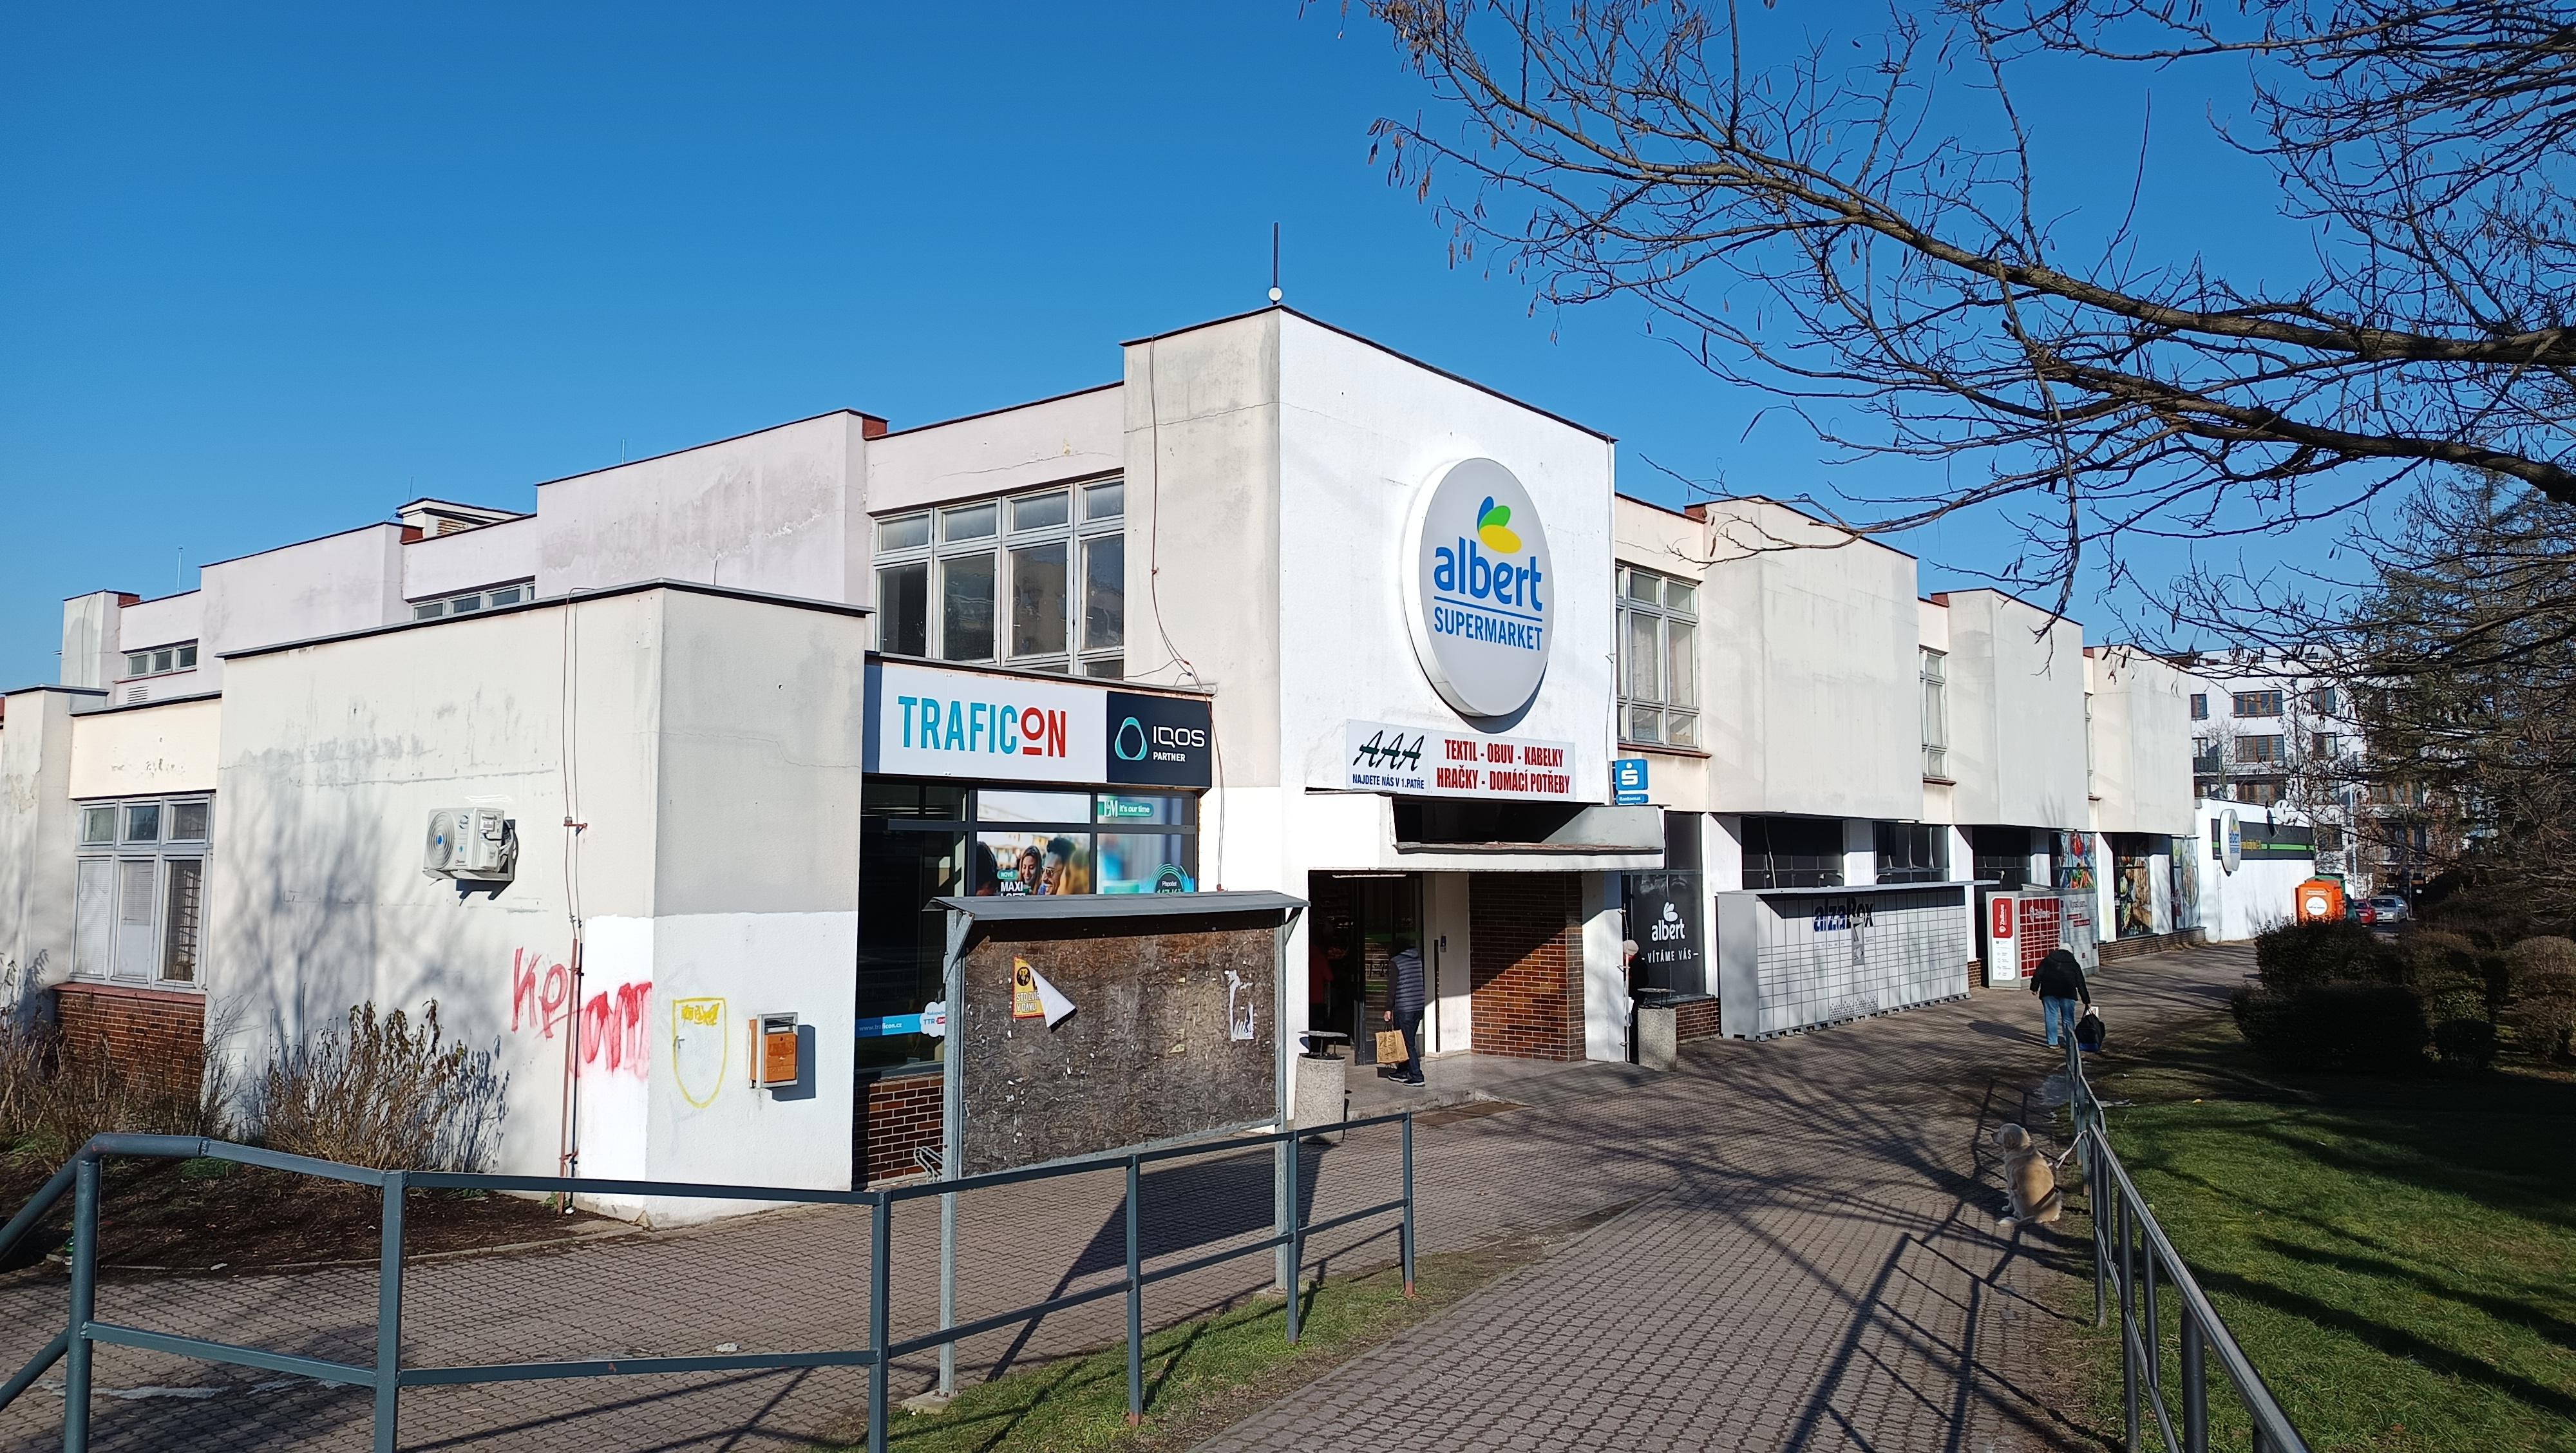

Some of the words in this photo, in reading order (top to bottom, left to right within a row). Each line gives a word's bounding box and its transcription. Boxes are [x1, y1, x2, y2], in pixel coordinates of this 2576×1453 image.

[1434, 536, 1543, 612] albert
[1434, 606, 1543, 651] SUPERMARKET
[898, 696, 1066, 758] TRAFICON
[1152, 725, 1206, 748] IQOS
[1153, 751, 1186, 763] PARTNER
[1353, 730, 1425, 772] AAA
[1444, 739, 1478, 761] TEXTIL
[1487, 743, 1514, 764] OBUV
[1524, 746, 1564, 768] KABELKY
[1352, 774, 1380, 786] NAJDETE
[1381, 775, 1394, 787] NÁS
[1395, 777, 1400, 787] V
[1401, 777, 1425, 789] 1.PATŘE
[1437, 764, 1479, 790] HRAČKY
[1490, 768, 1528, 792] DOMÁCÍ
[1530, 770, 1570, 793] POTŘEBY
[1000, 881, 1023, 892] MAXI
[1651, 918, 1685, 942] albert
[1647, 949, 1675, 964] VÍTÁME
[1678, 947, 1692, 960] VÁS
[1016, 992, 1028, 1002] STO
[1016, 1003, 1021, 1012] V
[858, 1022, 902, 1031] www.traficon.cz
